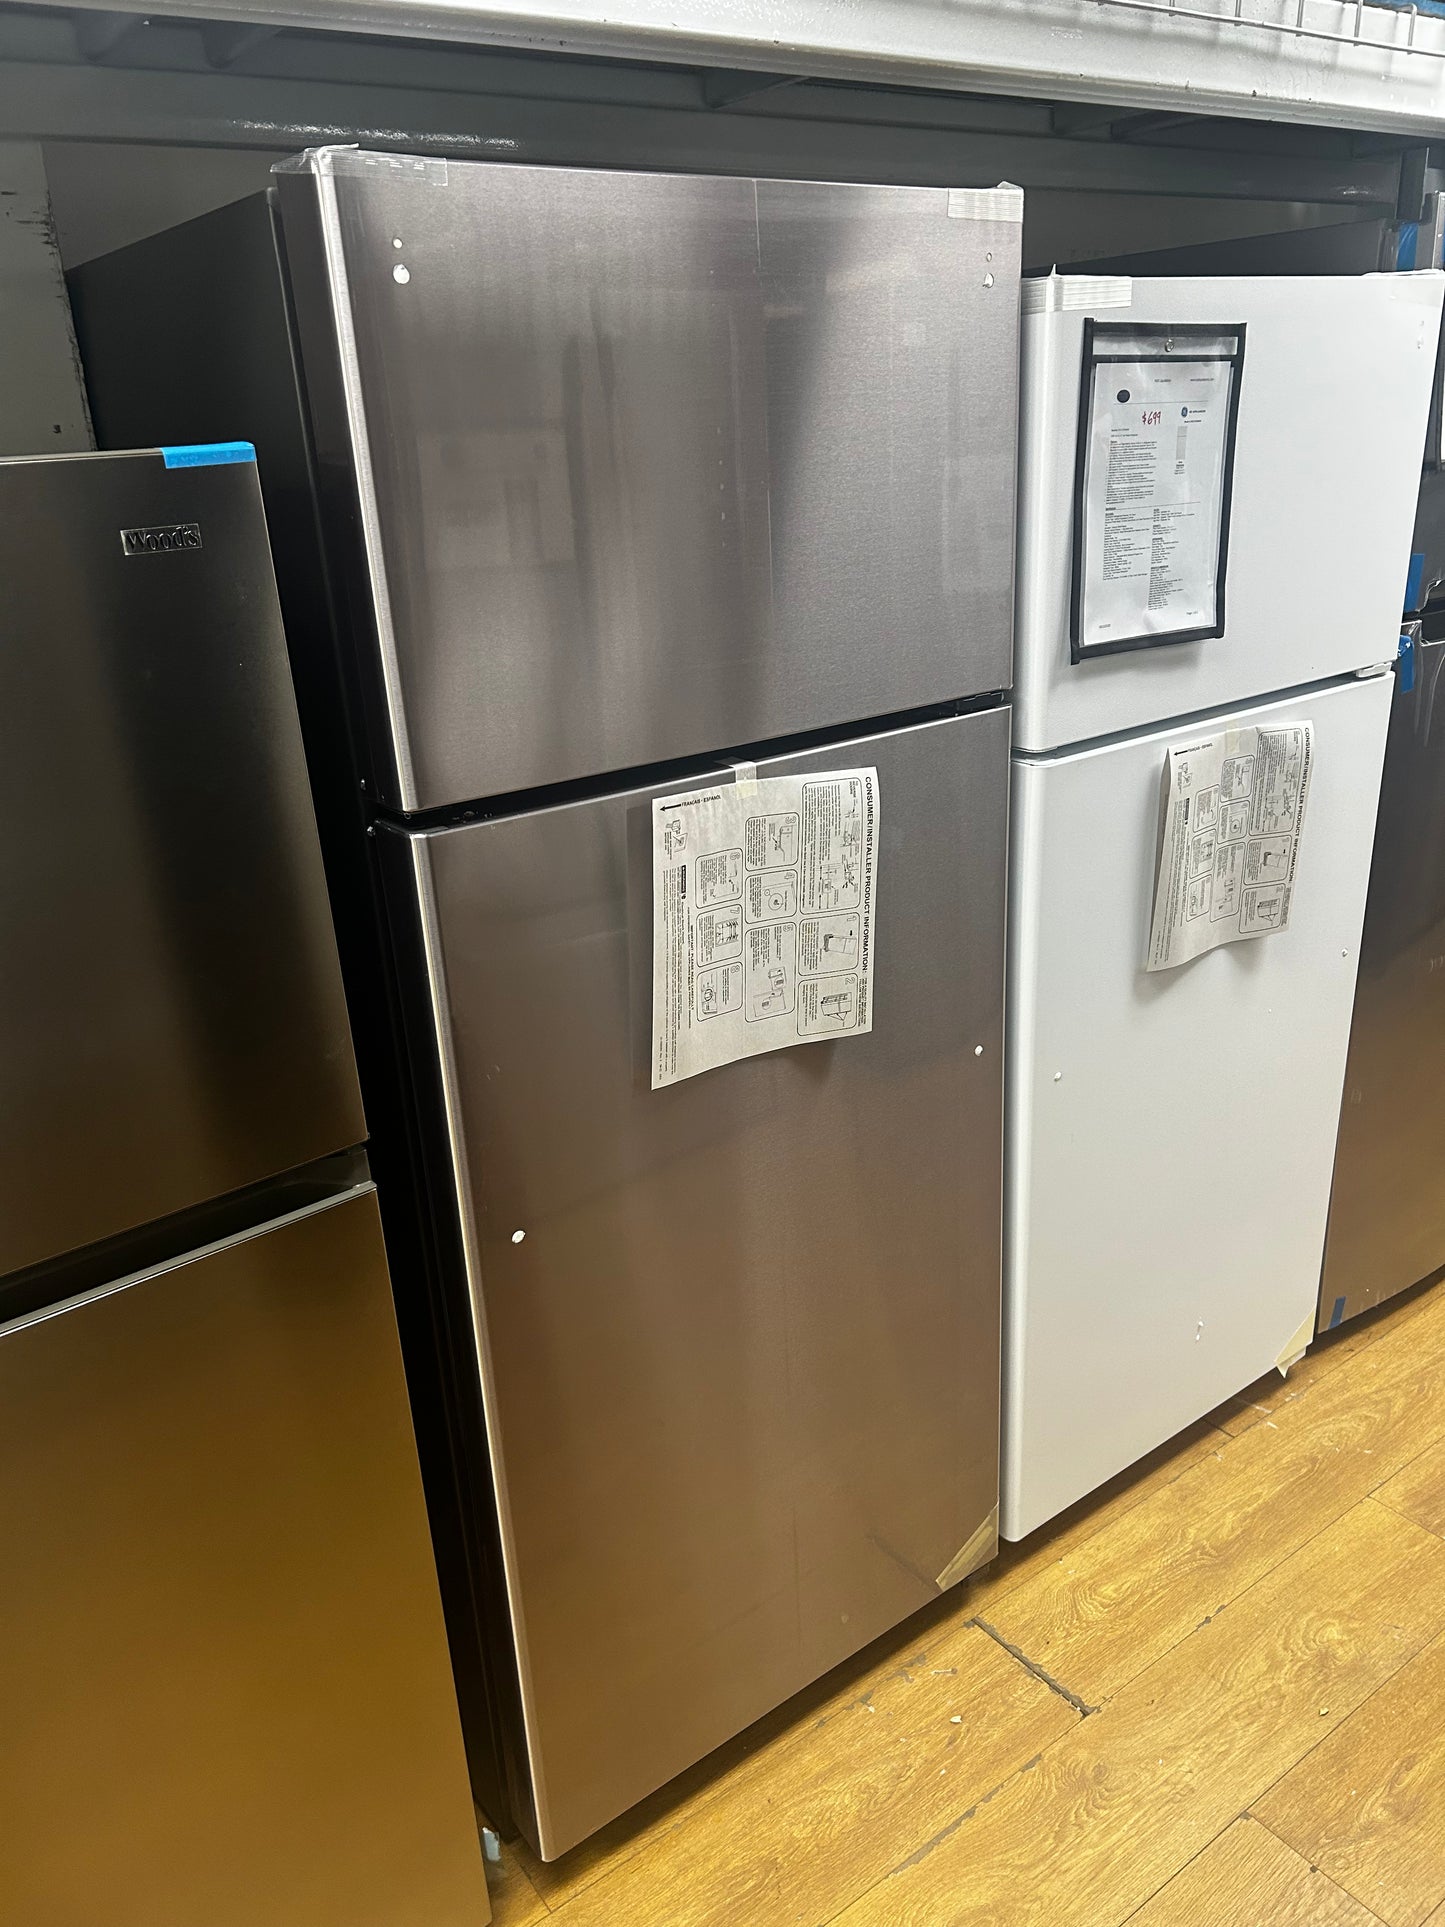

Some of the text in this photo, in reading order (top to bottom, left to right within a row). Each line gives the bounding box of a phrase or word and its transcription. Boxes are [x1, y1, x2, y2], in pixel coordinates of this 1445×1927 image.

[1142, 411, 1161, 425] $699
[1297, 727, 1310, 806] CONSUMER/INSTALLER
[865, 776, 873, 875] CONSUMER/INSTALLER
[1295, 807, 1303, 837] PRODUCT
